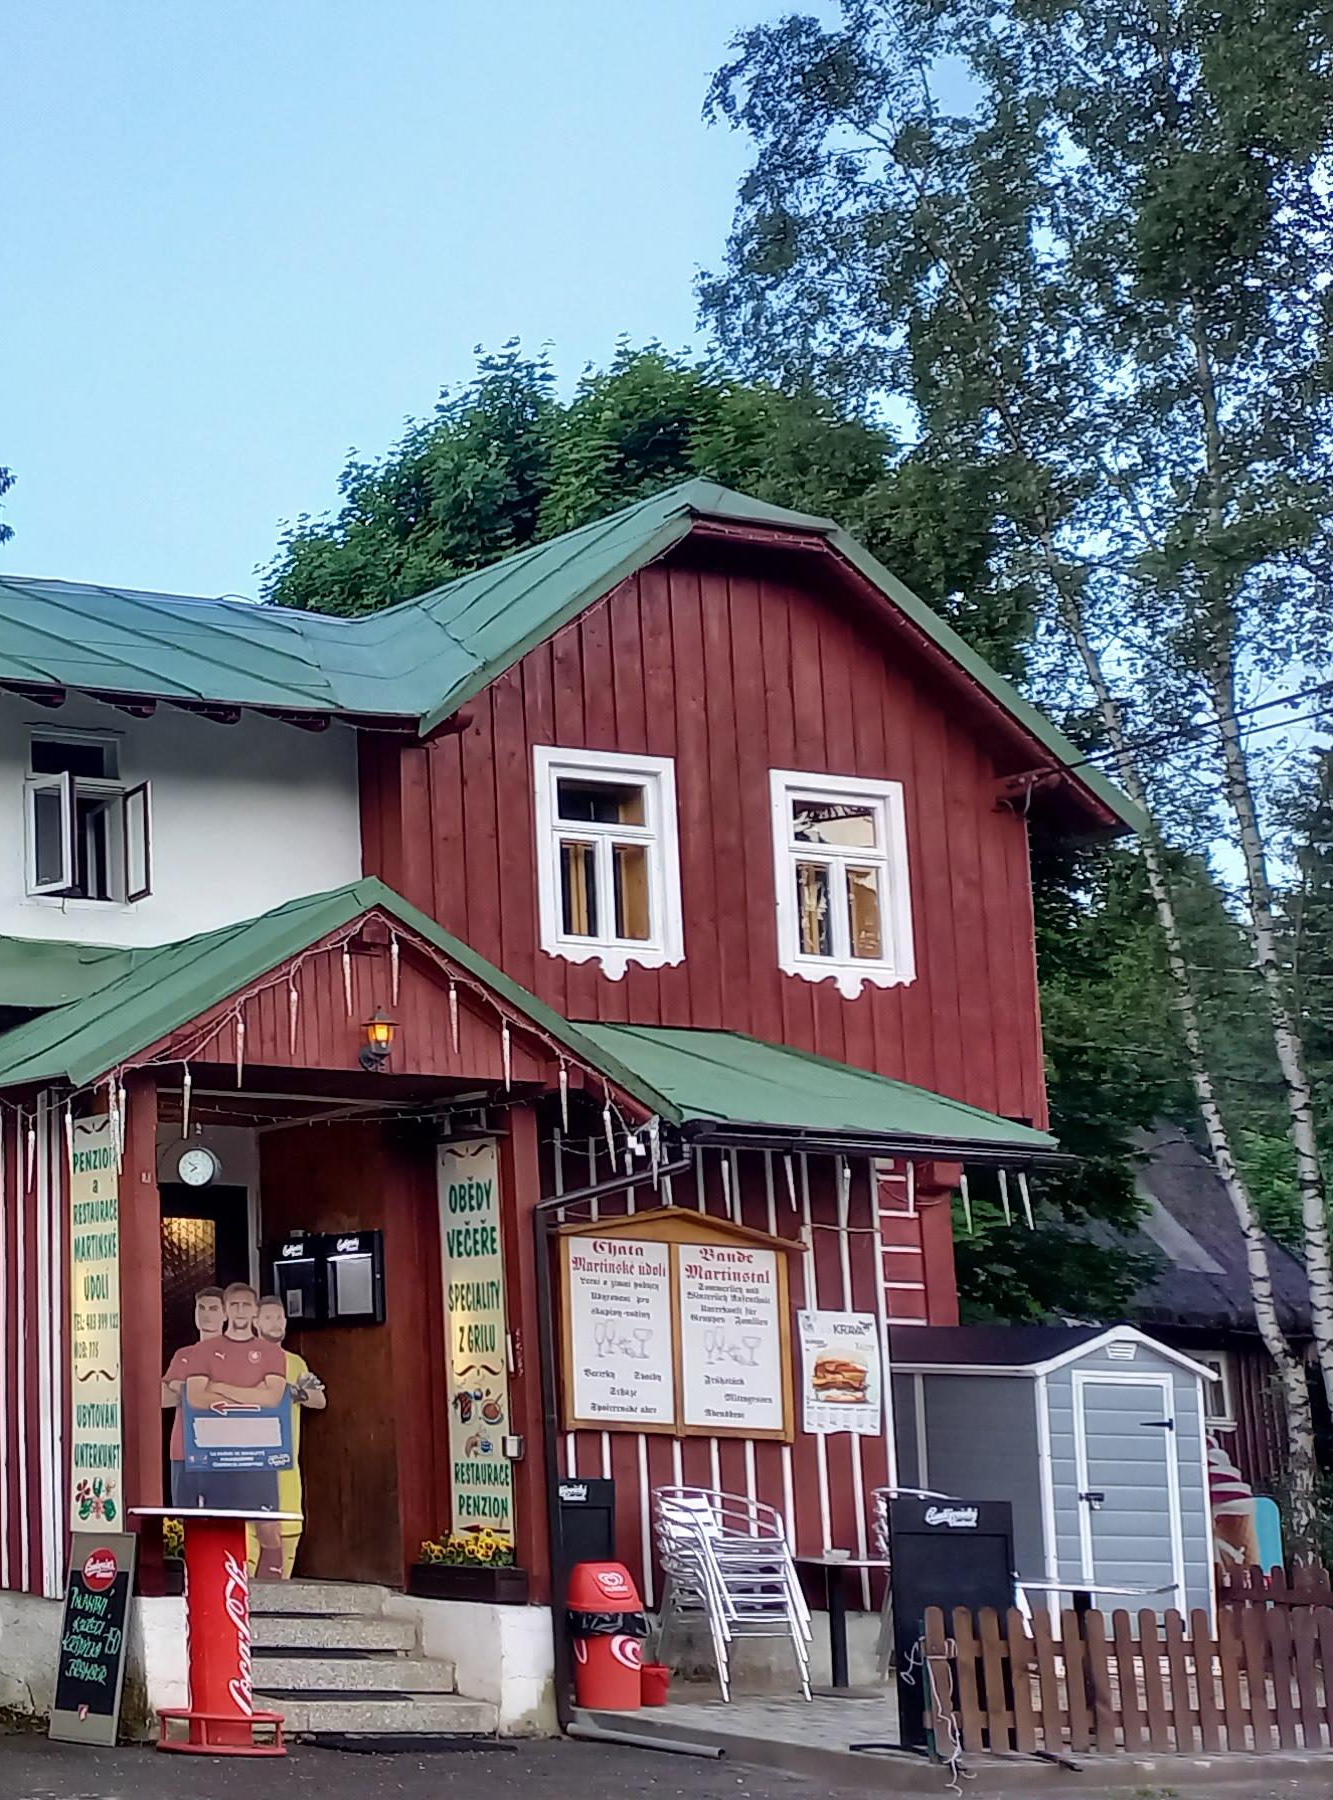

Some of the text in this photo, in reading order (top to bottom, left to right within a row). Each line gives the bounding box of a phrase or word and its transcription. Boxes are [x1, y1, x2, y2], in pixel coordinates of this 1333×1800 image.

[93, 1179, 98, 1193] a
[449, 1176, 492, 1214] OBĚDY
[73, 1199, 117, 1226] RESTAURACE
[74, 1228, 117, 1263] MARTINSKÉ
[447, 1219, 498, 1258] VEČEŘE
[592, 1240, 644, 1257] Chata
[572, 1256, 635, 1275] Martinské
[685, 1264, 770, 1284] Martinstal
[83, 1267, 109, 1301] ÚDOLÍ
[448, 1279, 501, 1312] SPECIALITY
[459, 1323, 496, 1354] Z GRILU
[76, 1398, 118, 1429] UBYTOVÁNÍ
[75, 1443, 120, 1470] UNTERKUNFT
[454, 1462, 510, 1487] RESTAURACE
[458, 1494, 509, 1518] PENZION
